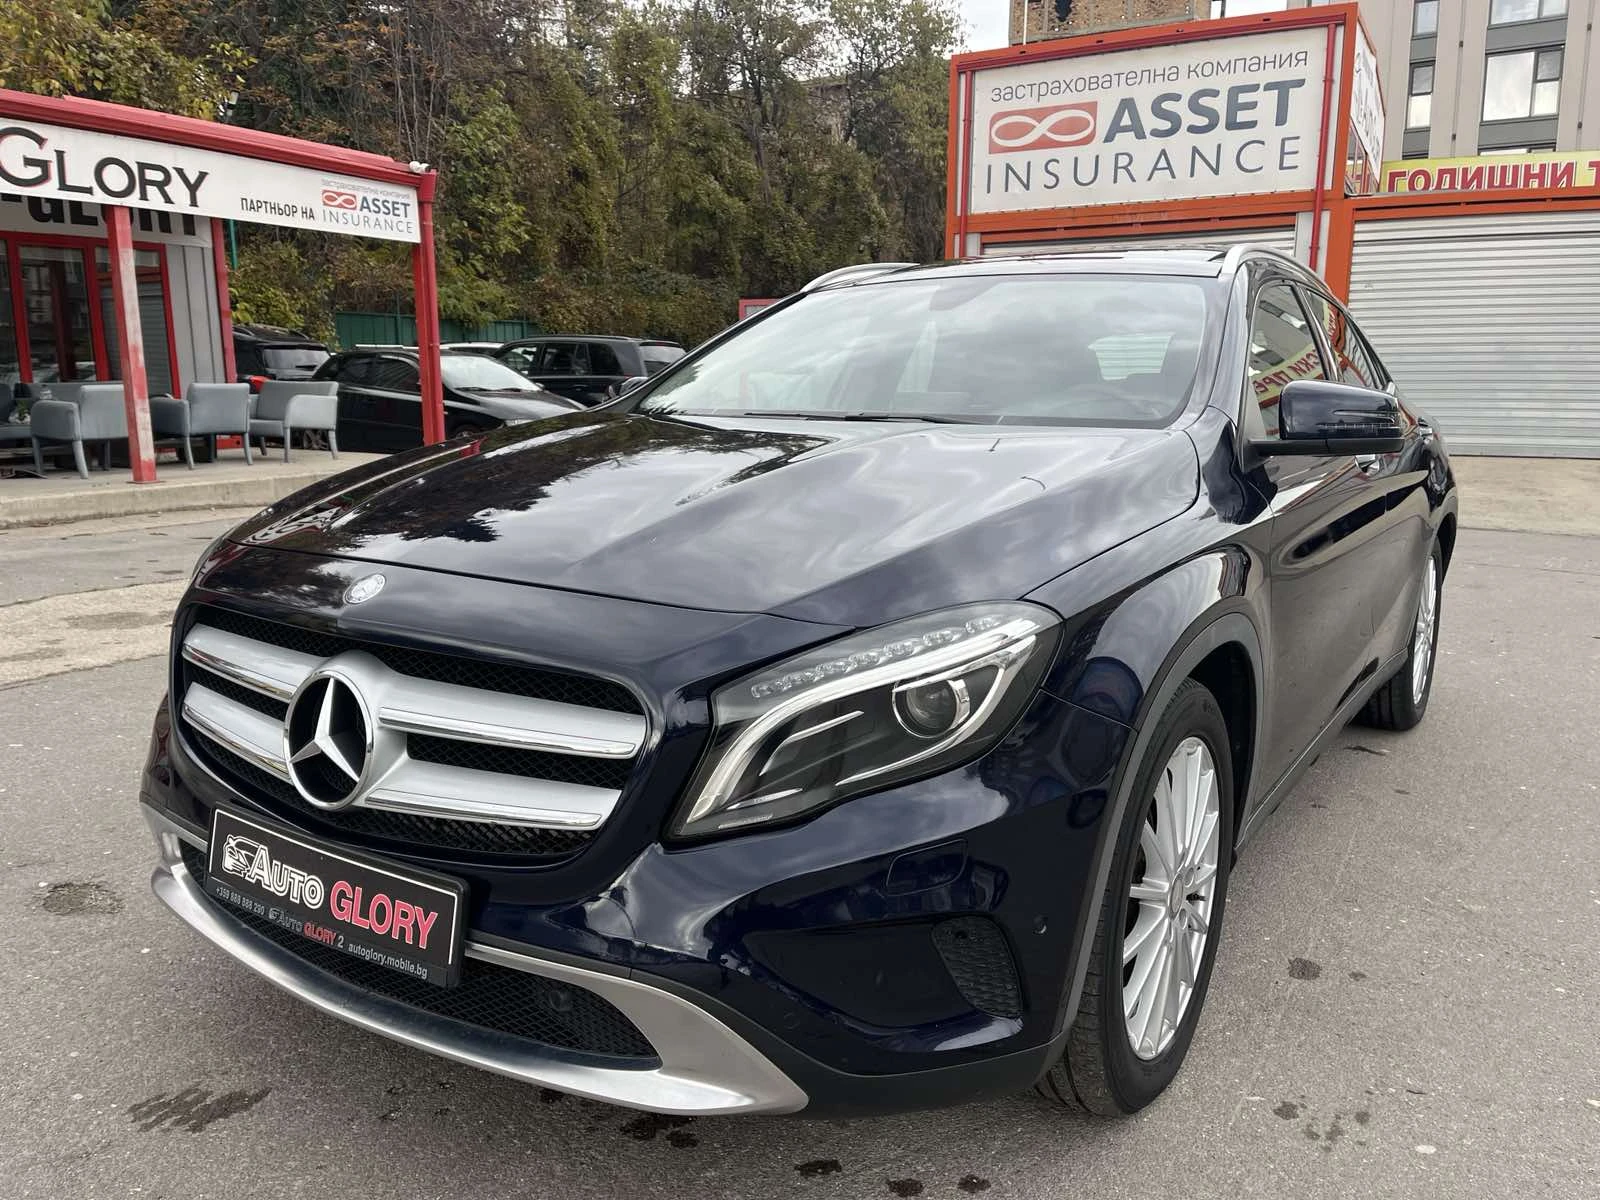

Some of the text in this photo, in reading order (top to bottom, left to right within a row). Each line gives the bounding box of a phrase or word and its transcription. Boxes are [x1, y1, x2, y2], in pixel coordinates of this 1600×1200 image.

[991, 50, 1309, 103] застрахователна компания
[1103, 78, 1306, 143] ASSET
[0, 126, 209, 207] GLORY
[986, 136, 1301, 194] INSURANCE
[240, 197, 315, 221] ПАРТНЬОР НА
[322, 209, 413, 234] INSURANCE
[360, 196, 411, 218] ASSET
[245, 846, 438, 950] AUTO GLORY
[304, 922, 336, 945] GLORY
[337, 935, 345, 949] 2
[348, 943, 428, 980] autoglory.mobile.bg
